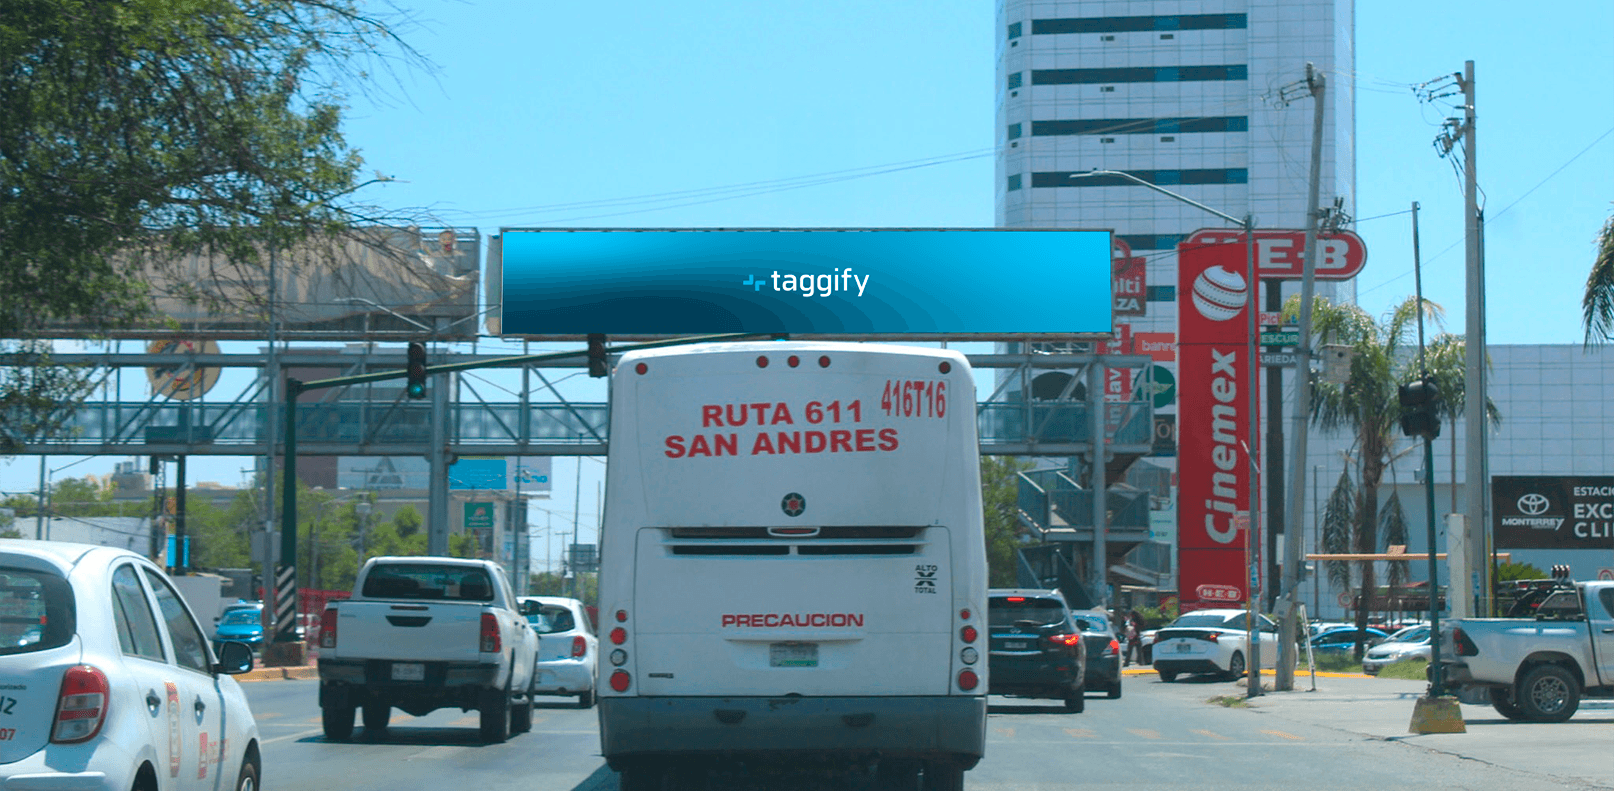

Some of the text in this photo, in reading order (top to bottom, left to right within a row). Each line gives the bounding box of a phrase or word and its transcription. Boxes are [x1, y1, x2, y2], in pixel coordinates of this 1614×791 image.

[770, 267, 870, 297] taggify
[702, 400, 862, 428] RUTA 611
[881, 380, 946, 418] 416T16
[664, 428, 899, 459] SAN ANDRES
[1205, 347, 1237, 544] Cinemex
[914, 586, 937, 594] TOTAL
[722, 613, 864, 628] PRECAUCION
